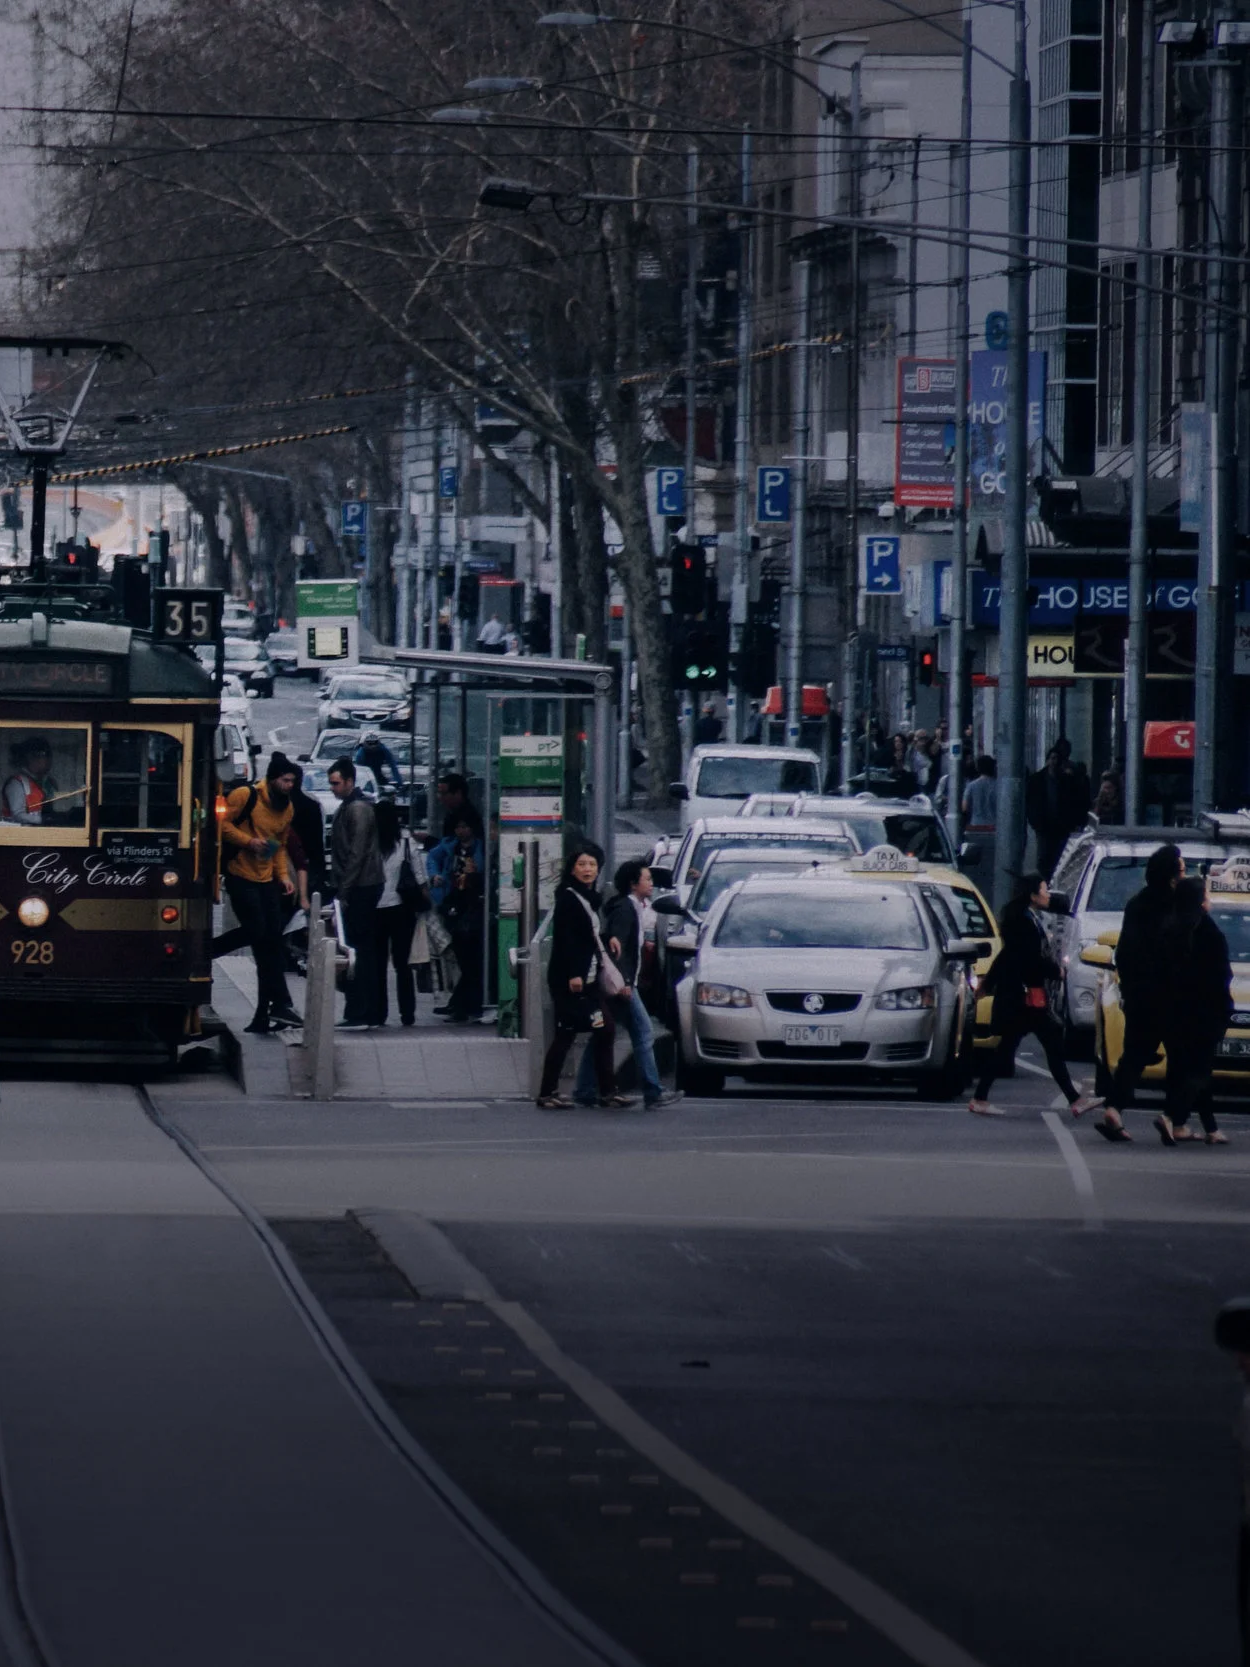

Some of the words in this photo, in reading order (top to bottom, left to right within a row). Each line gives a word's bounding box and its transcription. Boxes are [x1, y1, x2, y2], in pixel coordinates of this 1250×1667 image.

[661, 472, 679, 493] P
[764, 471, 784, 496] P
[346, 504, 362, 522] P
[872, 541, 894, 567] P
[165, 600, 208, 637] 35
[34, 662, 109, 683] CIRCLE
[107, 847, 121, 856] via
[123, 845, 160, 856] Flinders
[162, 846, 174, 856] St
[874, 852, 899, 861] TAXI
[22, 851, 81, 895] City
[83, 853, 151, 886] Circle
[863, 861, 886, 870] BLACK
[889, 861, 908, 870] CABS
[1211, 880, 1243, 891] Black
[10, 940, 55, 965] 928
[787, 1028, 809, 1041] ZDG
[818, 1028, 840, 1041] 019
